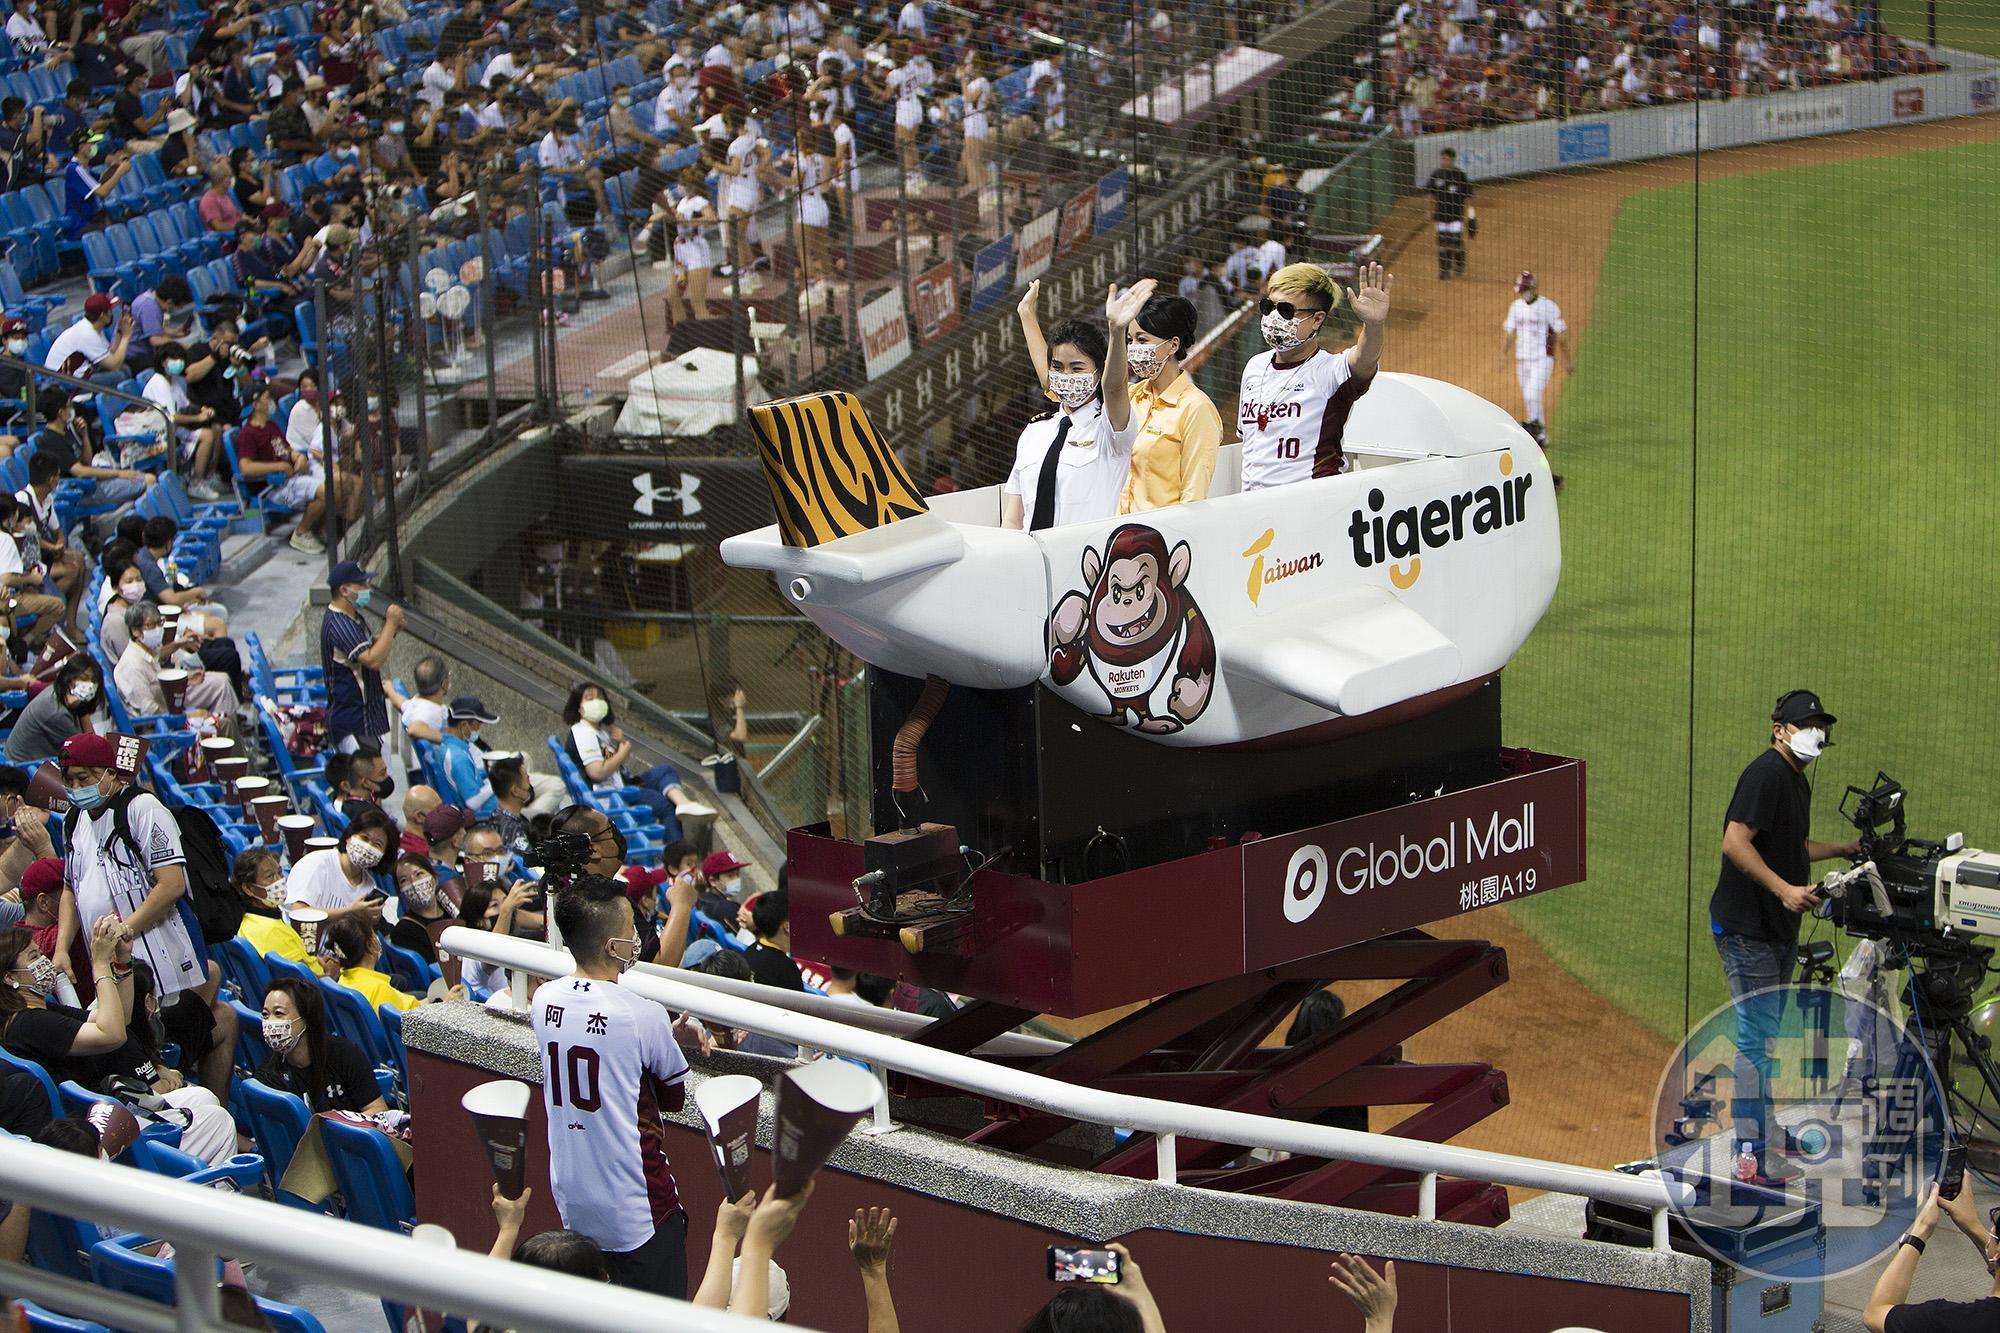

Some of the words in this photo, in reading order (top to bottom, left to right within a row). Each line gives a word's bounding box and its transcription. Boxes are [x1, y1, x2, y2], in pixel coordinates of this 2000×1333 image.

[1242, 399, 1302, 418] akuten
[1277, 437, 1300, 459] 10
[1348, 452, 1533, 590] tigerair
[1242, 527, 1325, 608] Taiwan
[1108, 669, 1146, 684] Rakuten
[1113, 684, 1140, 695] MONKEYS
[1335, 821, 1455, 895] Global
[1466, 802, 1535, 864] Mall
[1459, 868, 1537, 911] 桃園A19
[547, 1041, 601, 1112] 10
